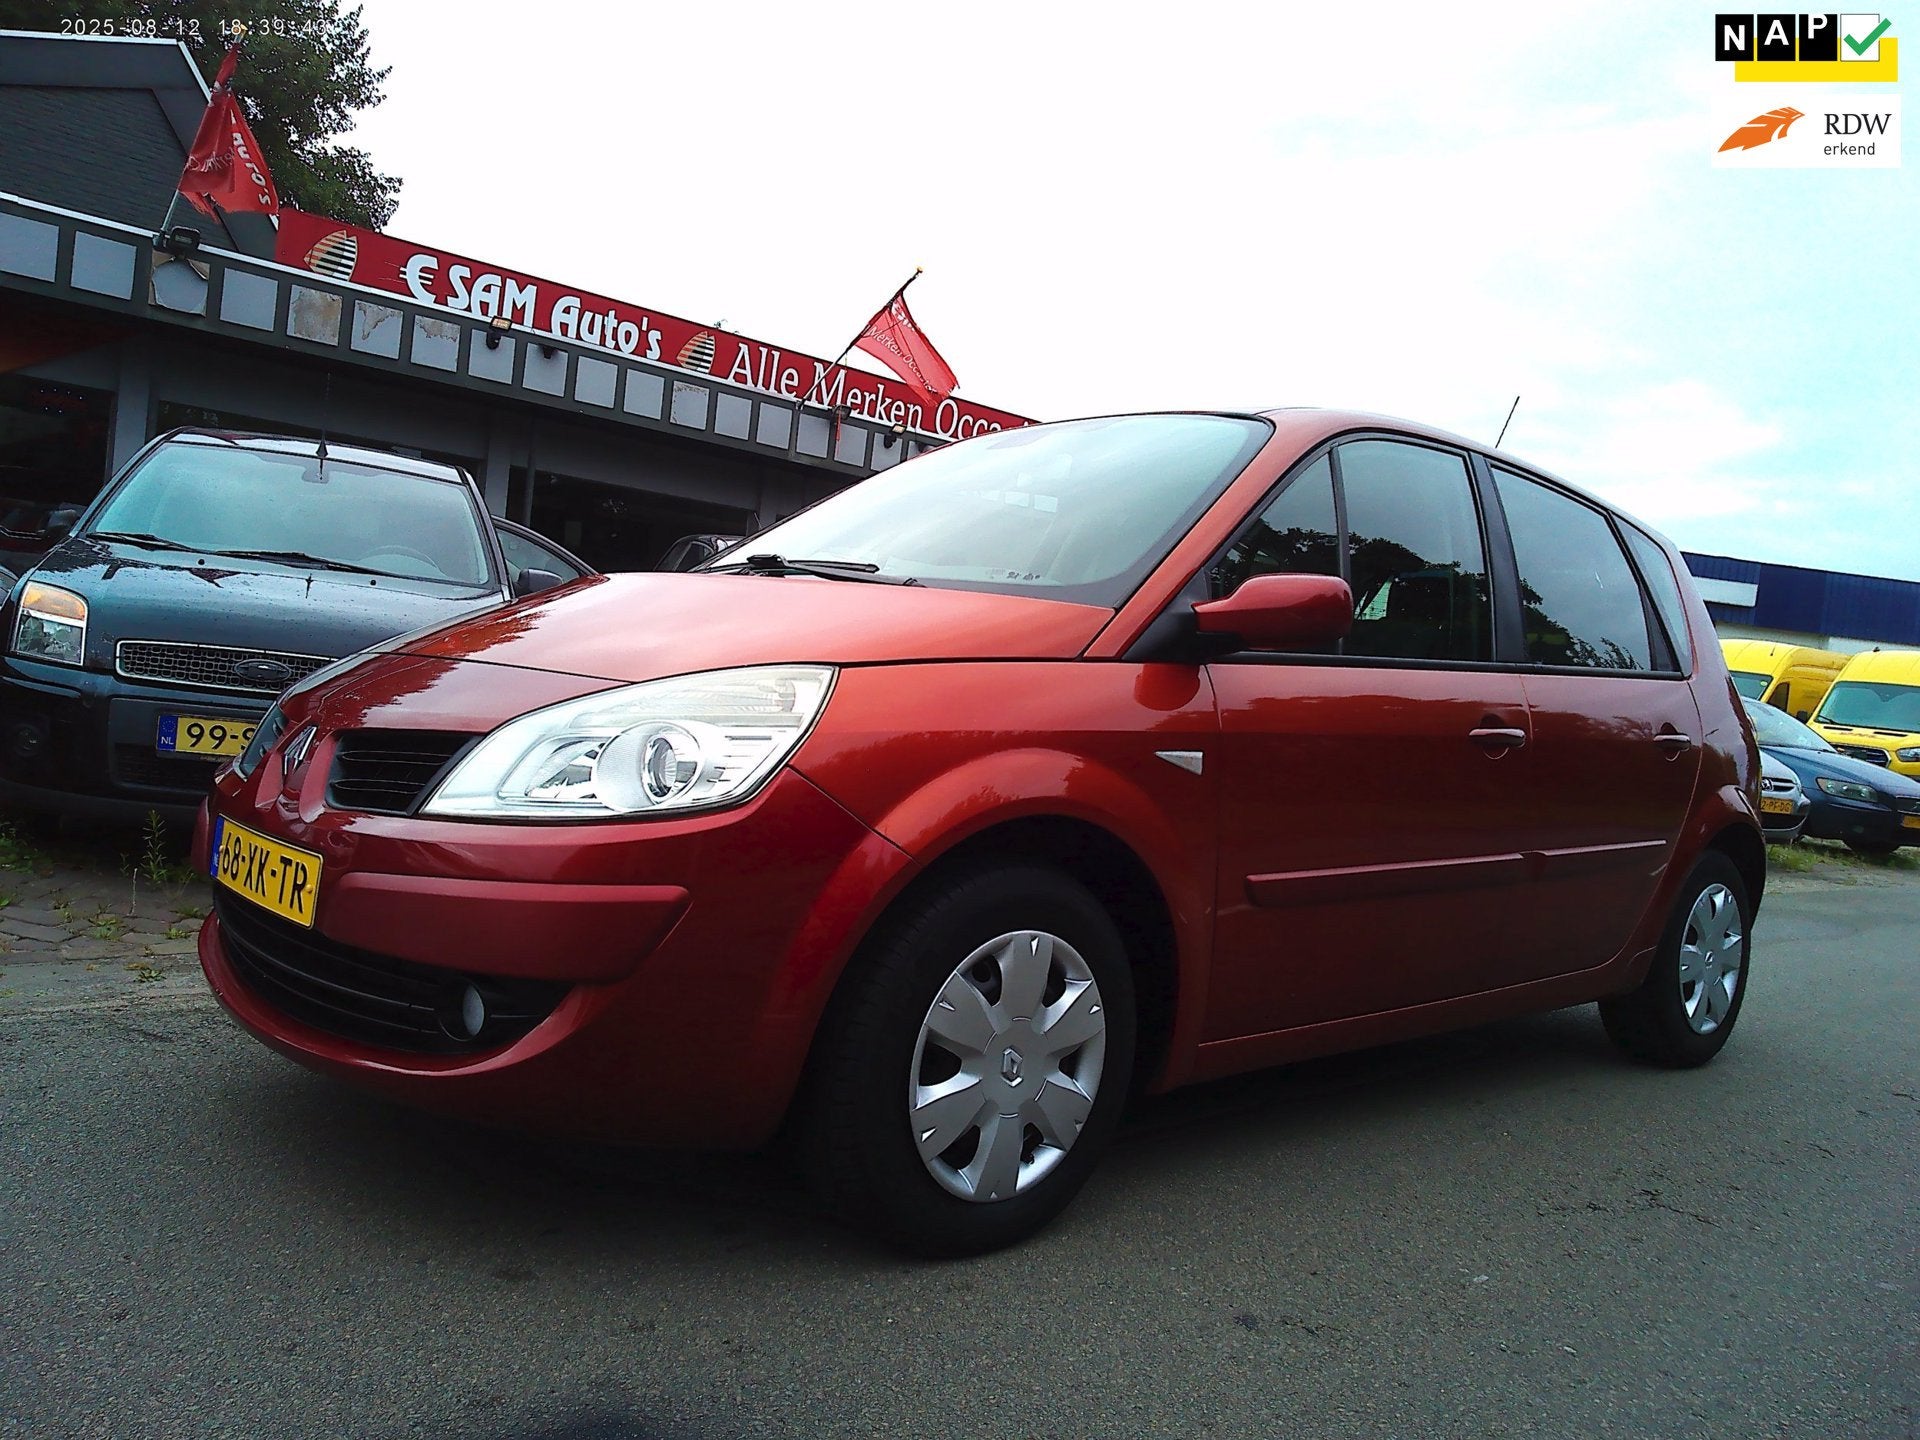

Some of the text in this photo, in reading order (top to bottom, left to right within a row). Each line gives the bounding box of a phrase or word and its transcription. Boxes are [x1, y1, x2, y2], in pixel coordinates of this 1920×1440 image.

[446, 264, 538, 330] SAM
[550, 295, 663, 361] Auto's
[728, 342, 799, 400] Alle
[810, 361, 923, 430] Merken
[160, 736, 174, 745] NL
[222, 832, 308, 914] 68-XK-TR
